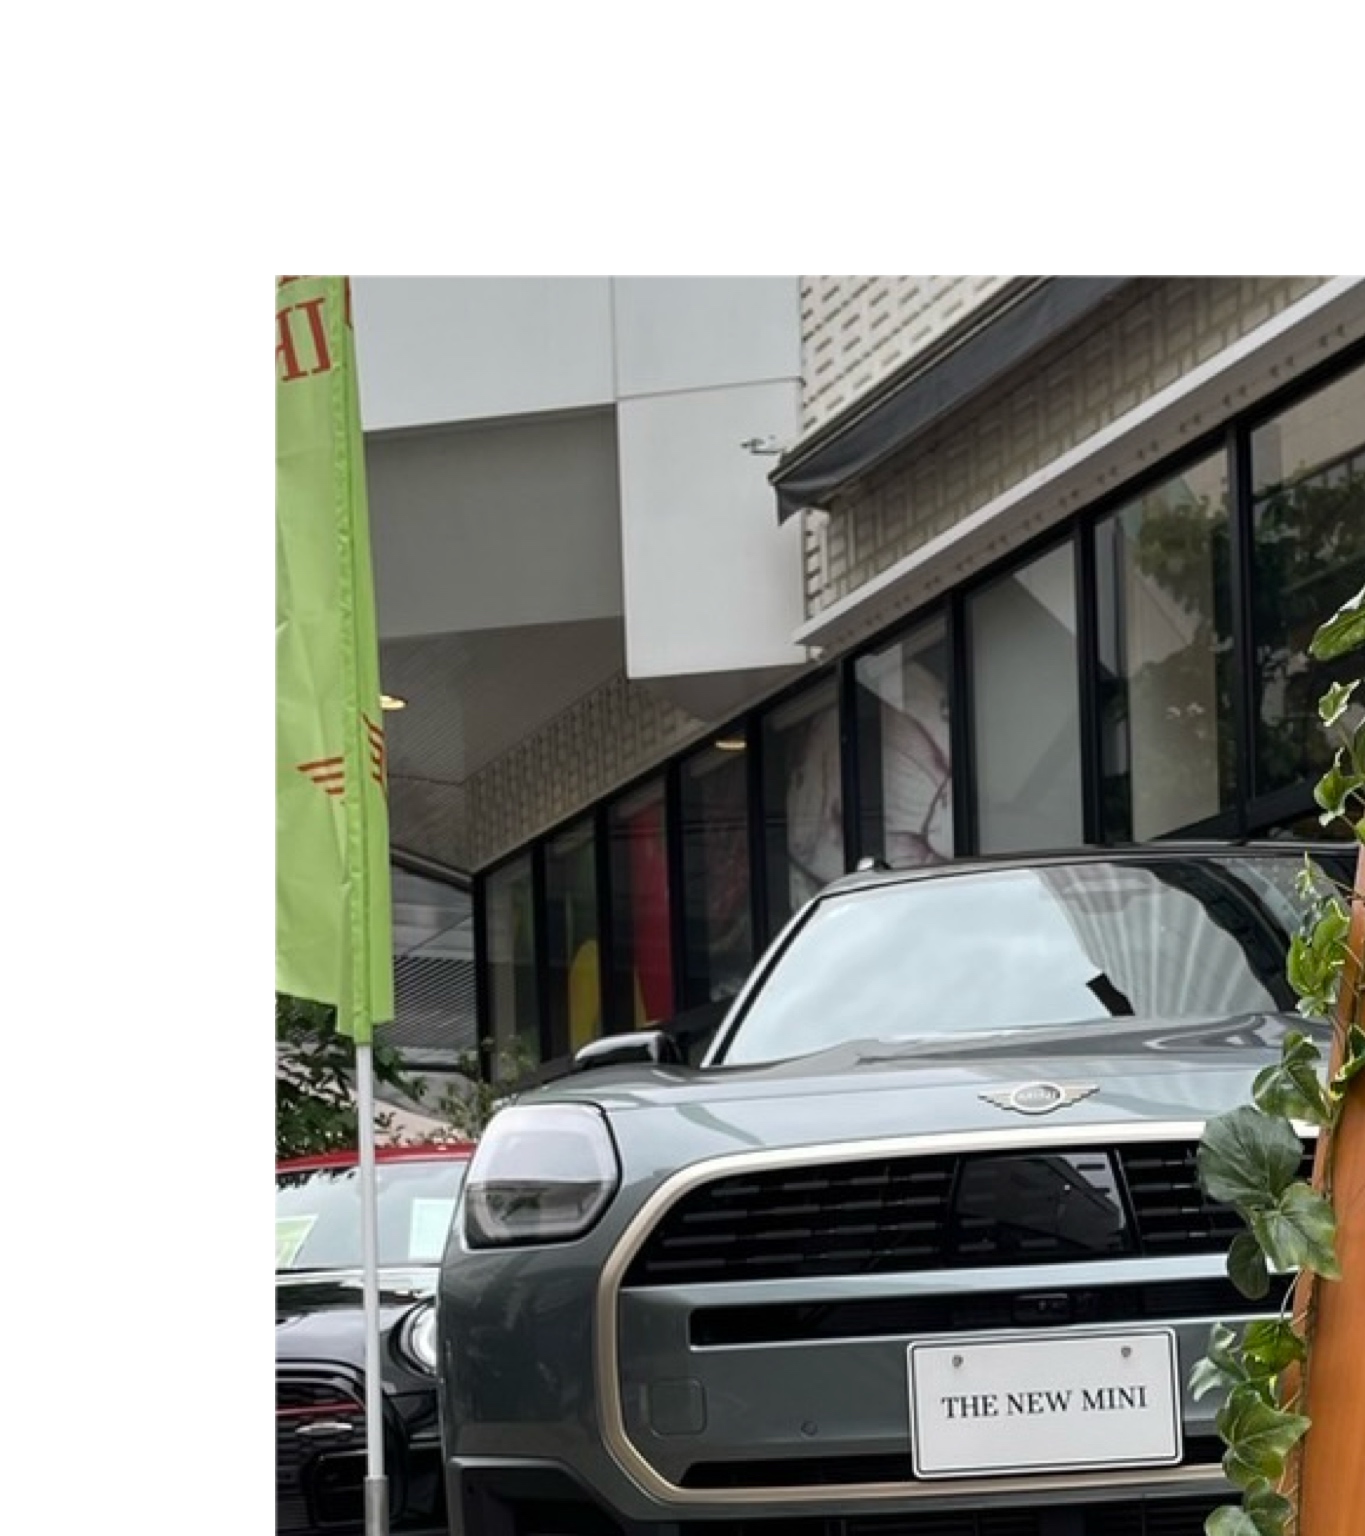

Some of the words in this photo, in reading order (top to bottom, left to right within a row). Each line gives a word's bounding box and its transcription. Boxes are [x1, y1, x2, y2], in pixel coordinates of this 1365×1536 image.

[941, 1396, 998, 1419] THE
[1005, 1390, 1072, 1416] NEW
[1081, 1386, 1147, 1410] MINI
